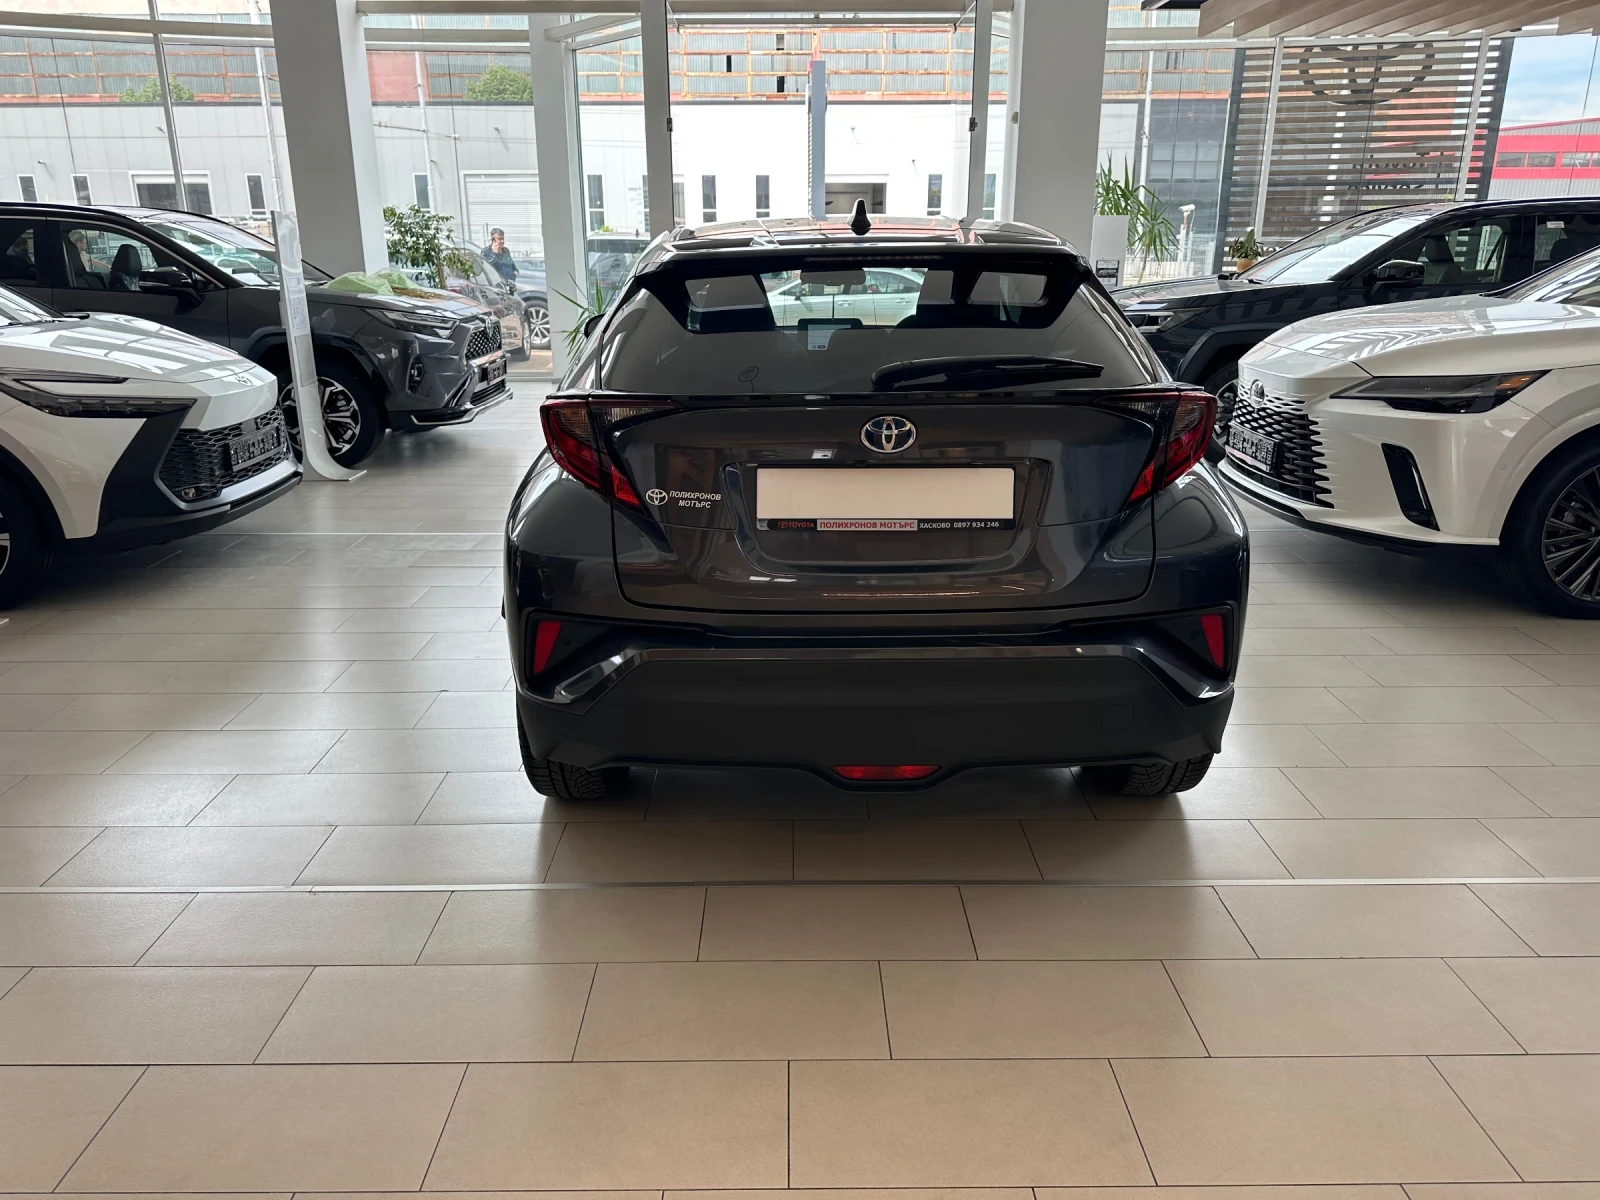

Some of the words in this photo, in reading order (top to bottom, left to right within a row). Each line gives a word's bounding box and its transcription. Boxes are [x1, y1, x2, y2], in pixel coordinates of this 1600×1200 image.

[669, 490, 722, 501] ПОЛИХРОНОВ
[678, 500, 712, 509] МОТЪРС
[819, 521, 878, 529] ПОЛИХРОНОВ
[879, 521, 916, 529] МОТЪРС
[919, 521, 951, 529] ХАСКОВО
